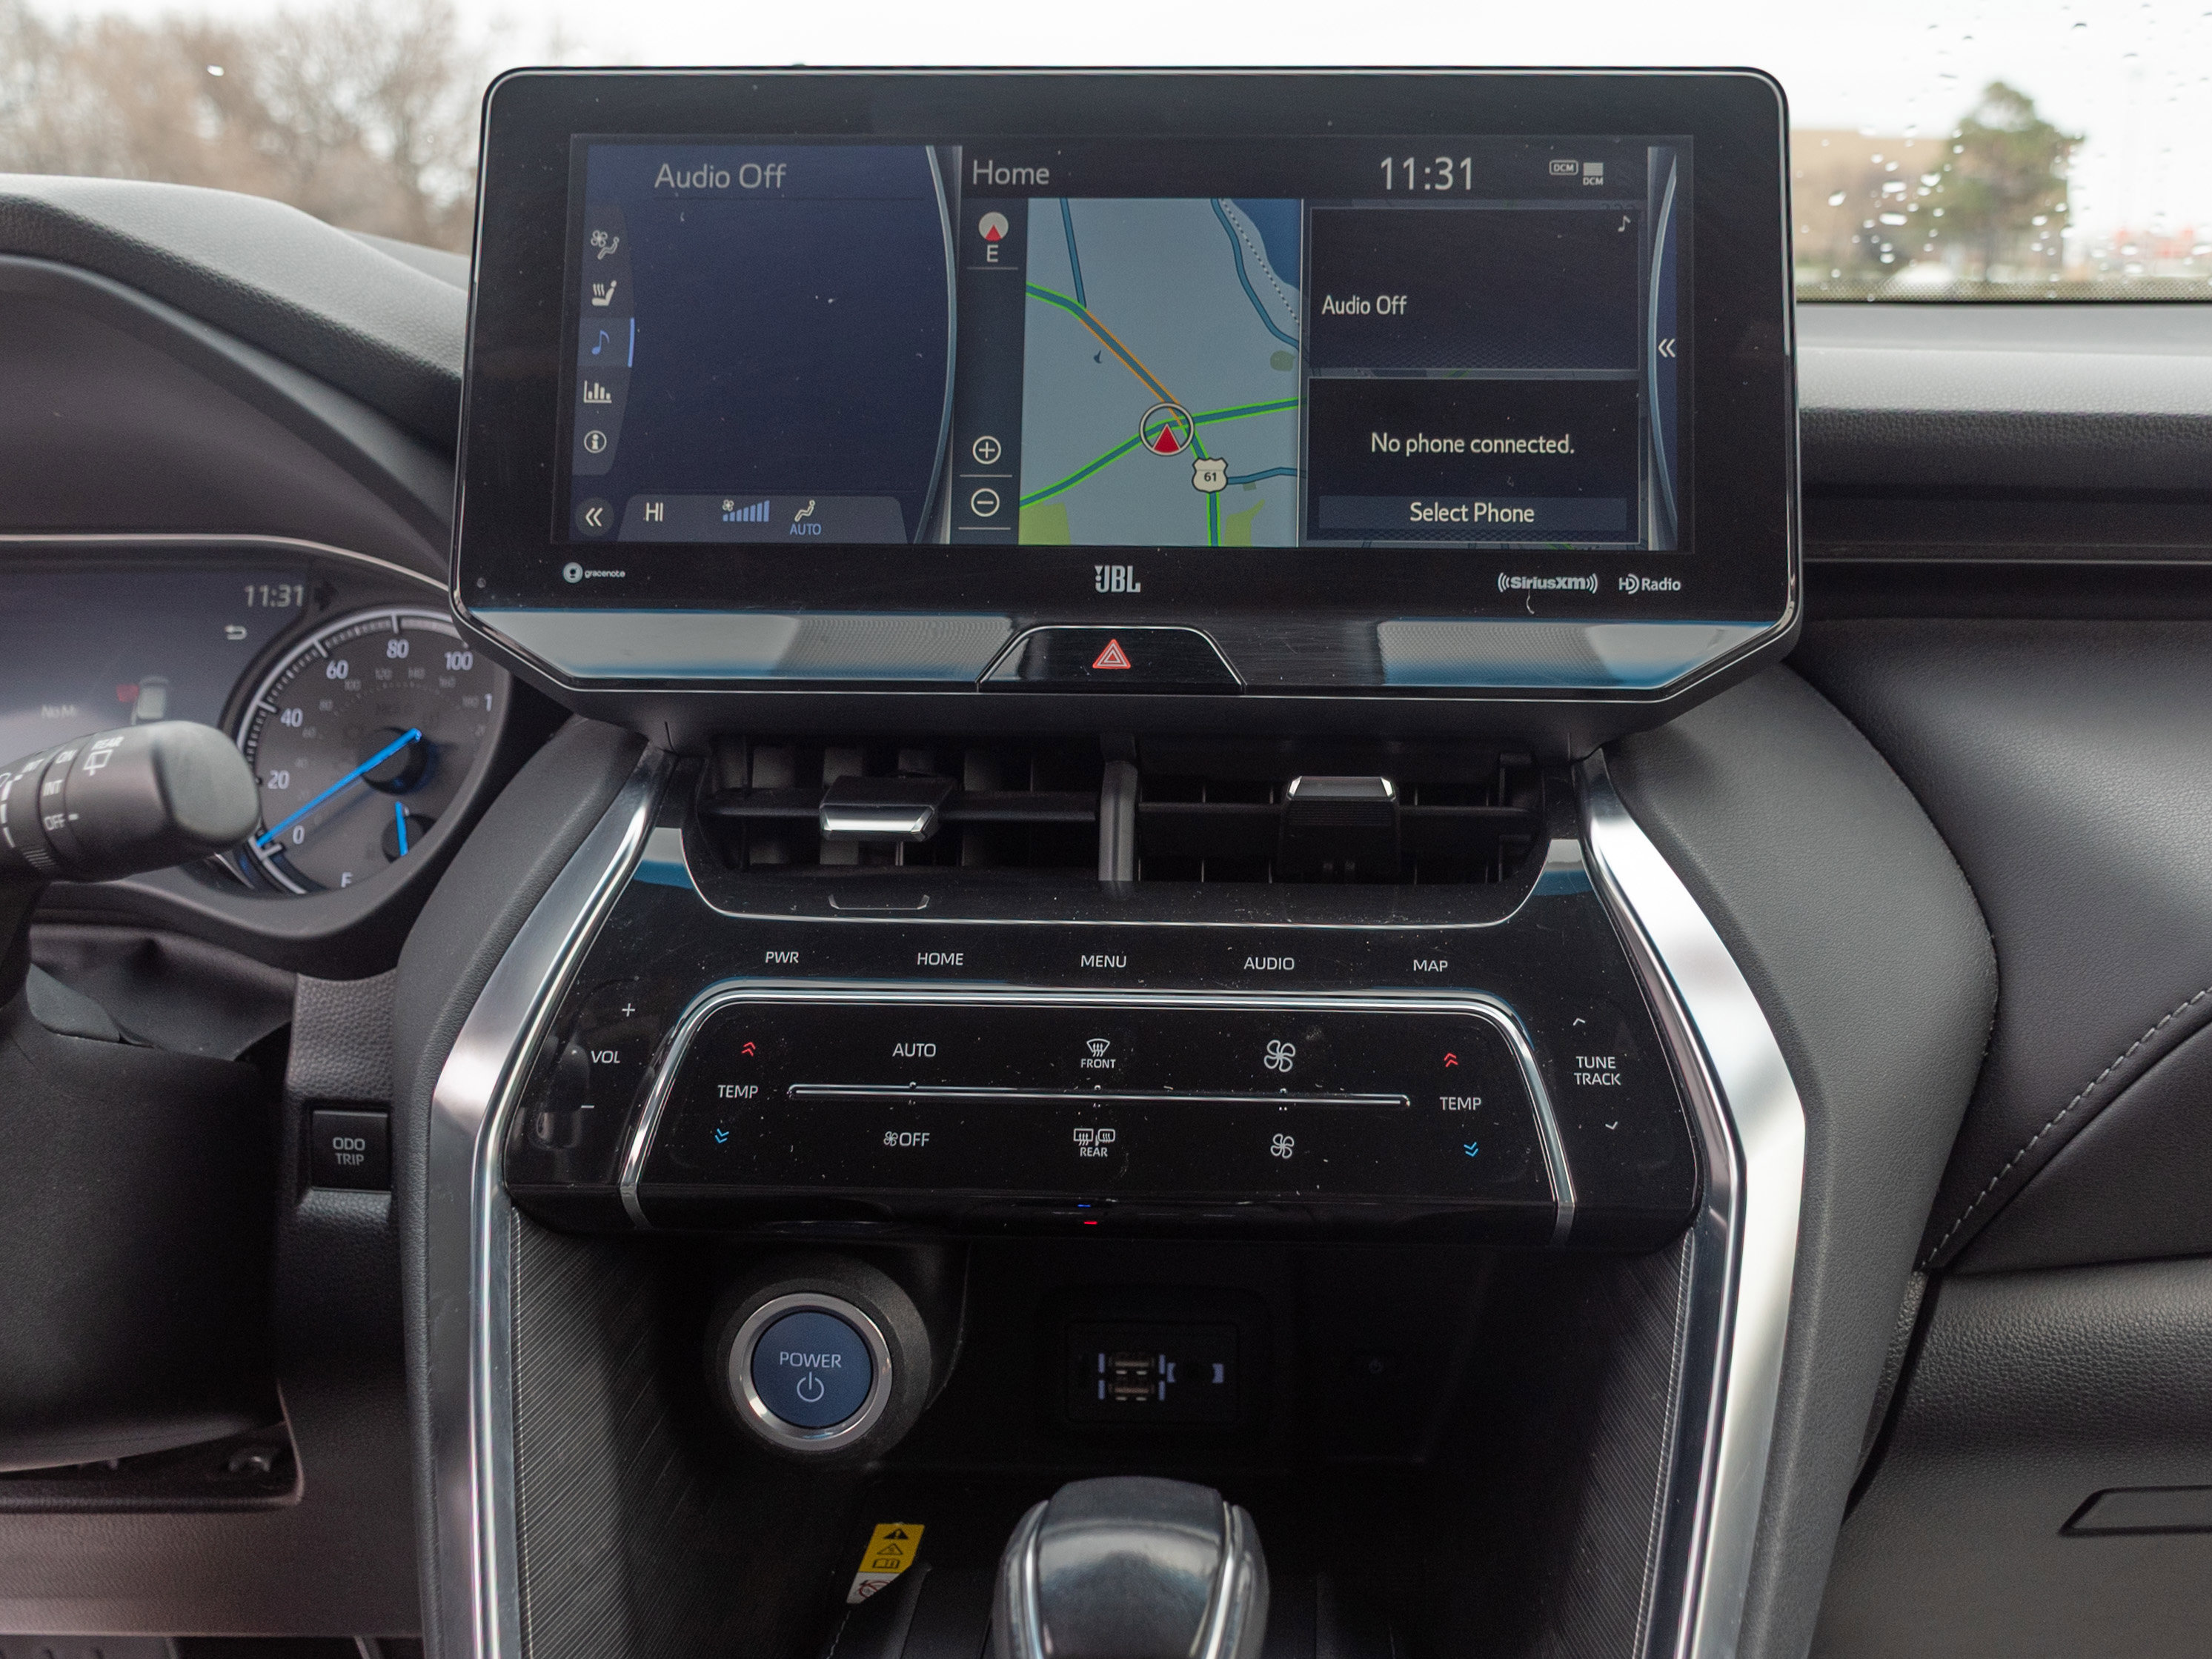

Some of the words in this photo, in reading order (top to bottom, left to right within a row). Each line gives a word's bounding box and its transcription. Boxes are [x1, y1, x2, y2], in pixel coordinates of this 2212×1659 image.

[972, 159, 1050, 185] Home
[1381, 156, 1472, 190] 11:31
[1553, 164, 1574, 172] DCM
[654, 163, 731, 188] Audio
[739, 163, 787, 189] Off
[1582, 176, 1604, 185] DCM
[986, 244, 999, 263] E
[1321, 294, 1371, 315] Audio
[1376, 295, 1407, 315] Off
[1371, 432, 1401, 453] No
[1406, 432, 1465, 457] phone
[1470, 433, 1575, 454] connected.
[1203, 471, 1217, 482] 61
[645, 502, 664, 522] HI
[1409, 502, 1469, 522] Select
[1474, 502, 1535, 523] Phone
[789, 522, 822, 536] AUTO
[584, 570, 626, 579] gracenote
[1095, 565, 1141, 593] JBL
[1641, 576, 1681, 591] Radio
[245, 585, 304, 608] 11:31
[386, 639, 409, 659] 80
[445, 651, 474, 671] 100
[325, 659, 349, 679] 60
[280, 708, 303, 728] 40
[92, 737, 124, 751] REAR
[268, 770, 290, 790] 20
[42, 779, 63, 797] INT
[44, 814, 65, 831] OFF
[292, 825, 305, 845] 0
[341, 872, 353, 888] F
[765, 951, 800, 963] PWR
[917, 952, 964, 966] HOME
[1080, 954, 1127, 968] MENU
[1243, 957, 1295, 971] AUDIO
[1413, 959, 1449, 972] MAP
[591, 1050, 620, 1064] VOL
[892, 1043, 937, 1057] AUTO
[1080, 1058, 1116, 1068] FRONT
[1575, 1056, 1616, 1069] TUNE
[1573, 1072, 1621, 1086] TRACK
[717, 1084, 759, 1099] TEMP
[1439, 1096, 1482, 1111] TEMP
[332, 1137, 366, 1151] ODO
[899, 1131, 930, 1147] OFF
[335, 1152, 365, 1166] TRIP
[1080, 1146, 1108, 1157] REAR
[780, 1351, 842, 1369] POWER
